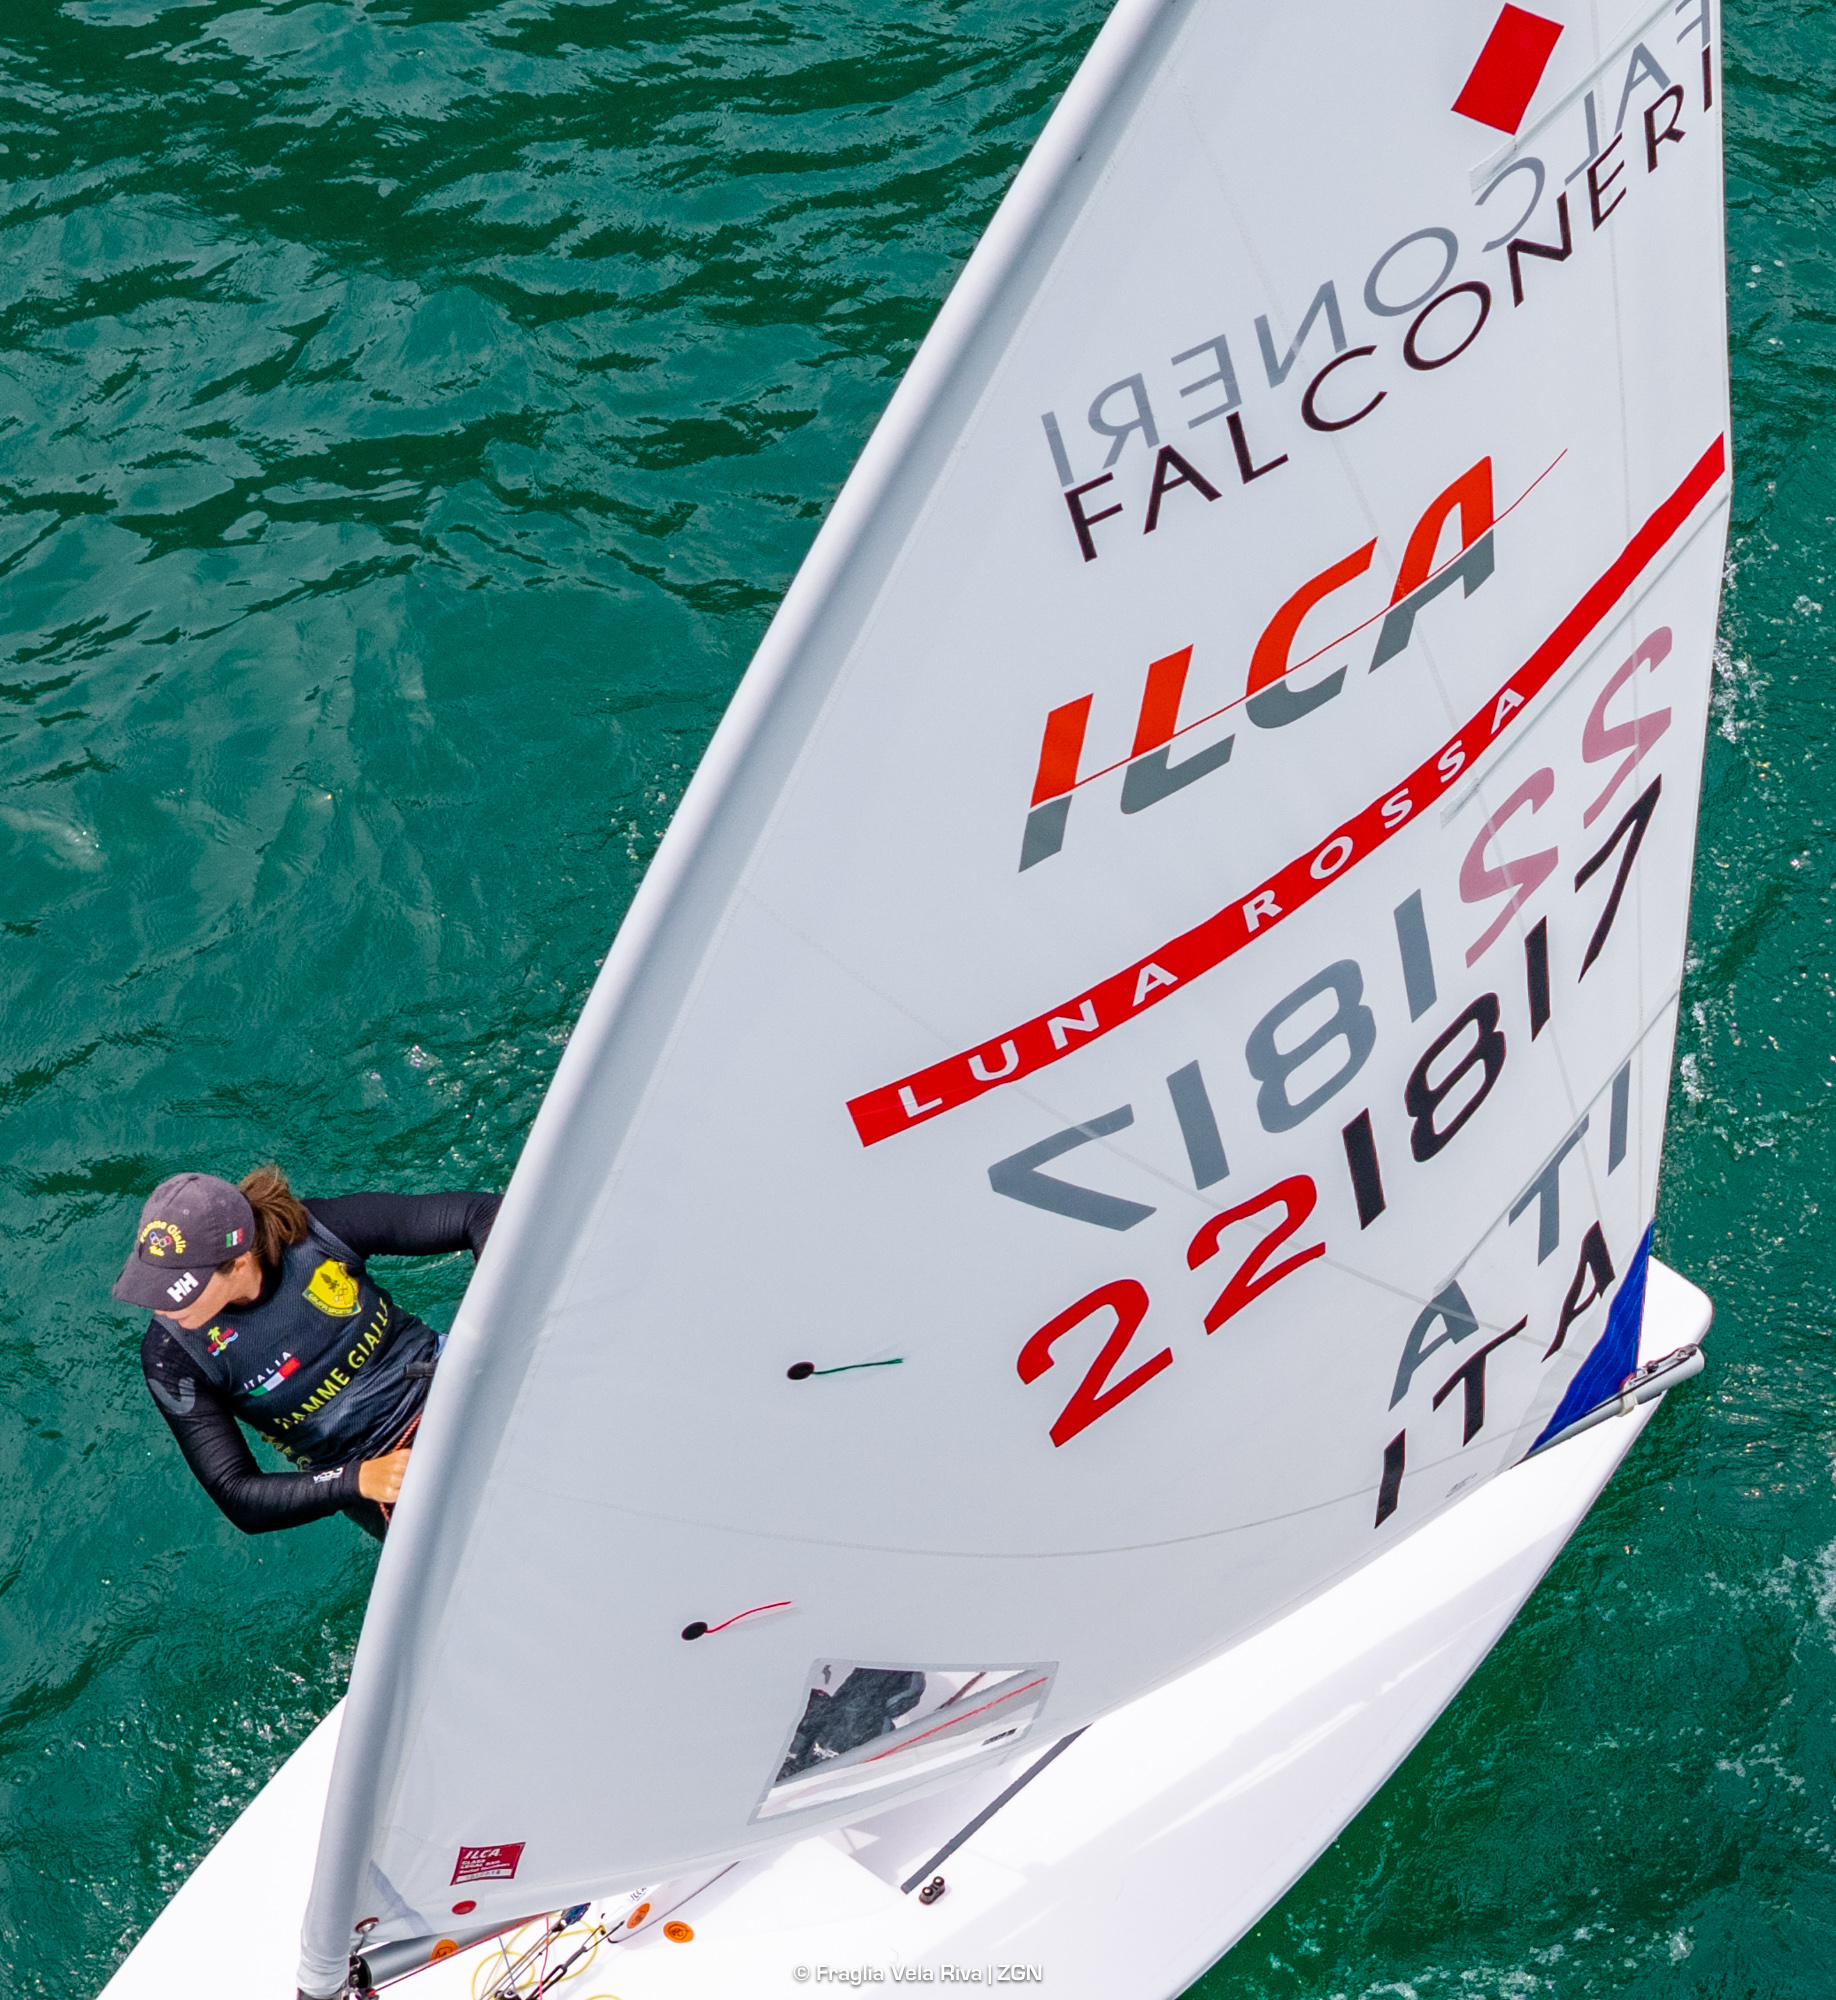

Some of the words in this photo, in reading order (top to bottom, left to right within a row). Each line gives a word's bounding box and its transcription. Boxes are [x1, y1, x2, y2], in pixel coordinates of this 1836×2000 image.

[1064, 44, 1712, 562] FALCONERI
[1019, 455, 1495, 873] ILCA
[897, 963, 1178, 1119] LUNA
[1242, 687, 1526, 933] ROSSA
[166, 1271, 199, 1303] HH
[1016, 774, 1662, 1448] 221817
[243, 1351, 292, 1391] ITALIA
[1374, 1220, 1616, 1530] ITA
[463, 1848, 501, 1860] ILCA
